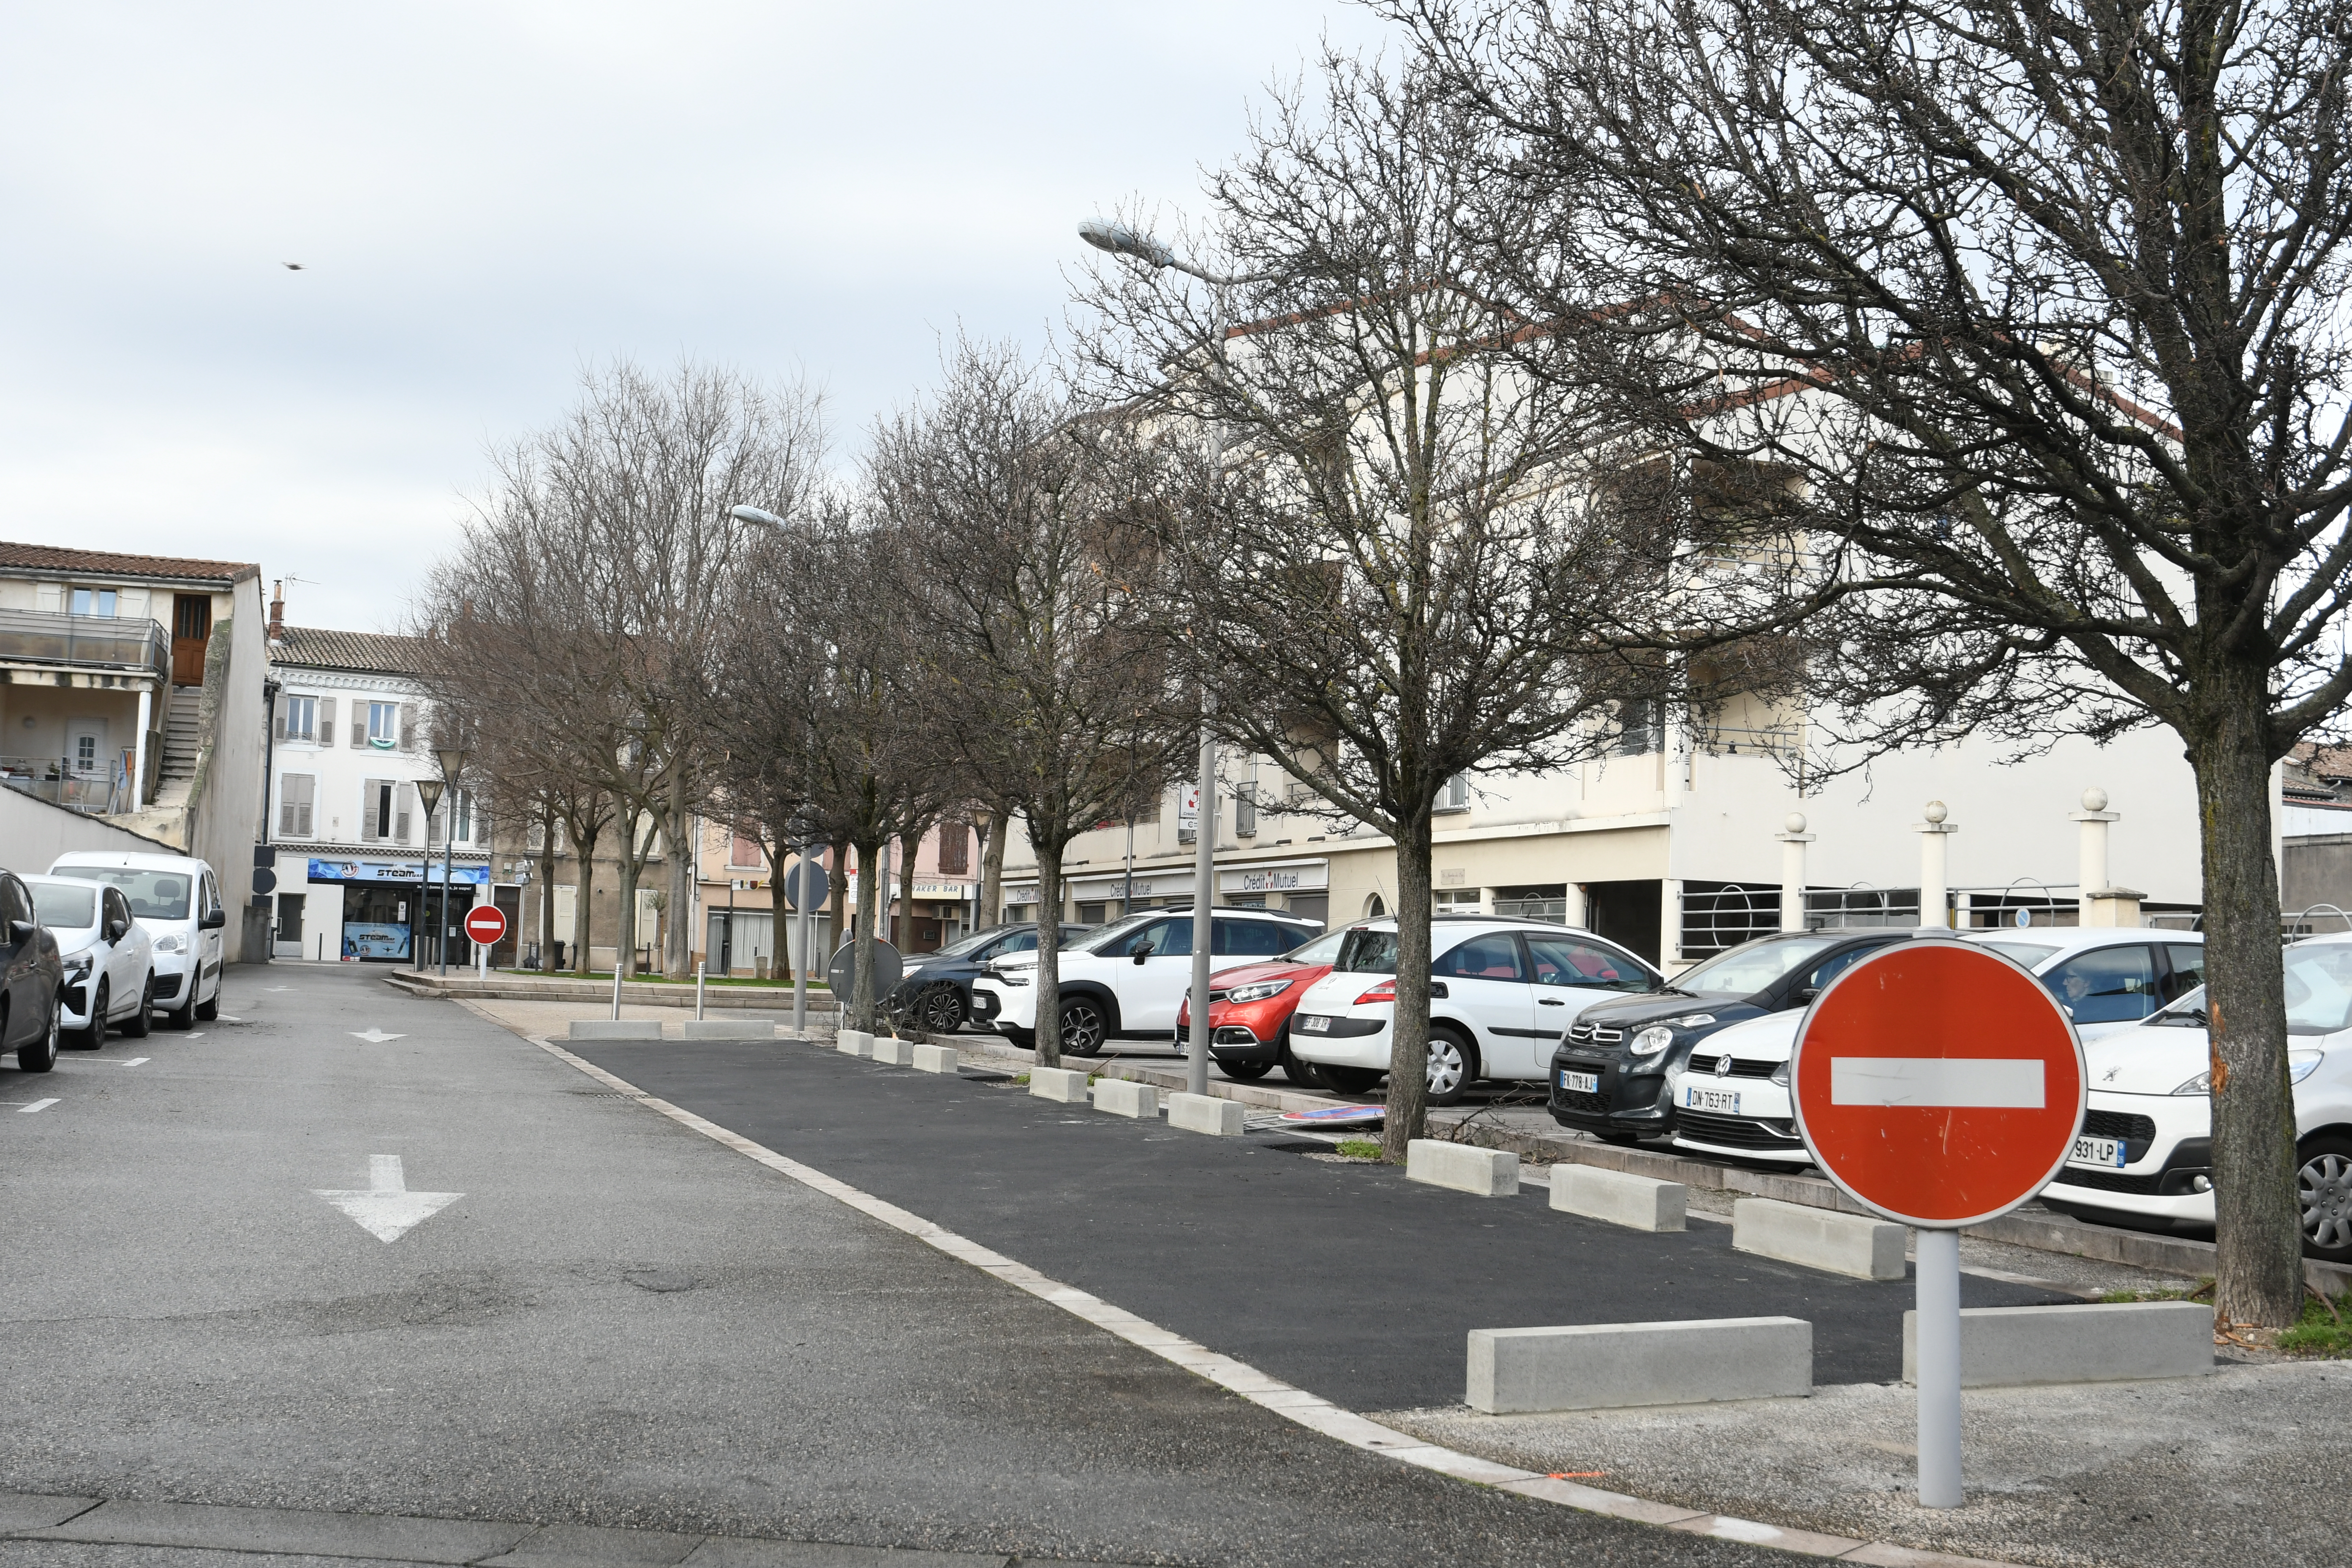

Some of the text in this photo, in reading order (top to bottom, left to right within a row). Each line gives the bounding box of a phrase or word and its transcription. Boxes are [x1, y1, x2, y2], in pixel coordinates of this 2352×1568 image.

[1111, 881, 1152, 897] Crédi Mutuel
[1244, 872, 1298, 890] Crédit Mutuel
[1017, 889, 1030, 901] Crédit
[1564, 1073, 1592, 1090] FK-778-AJ
[1693, 1090, 1733, 1109] DN-763-RT
[2075, 1140, 2124, 1163] 931-LP 26
